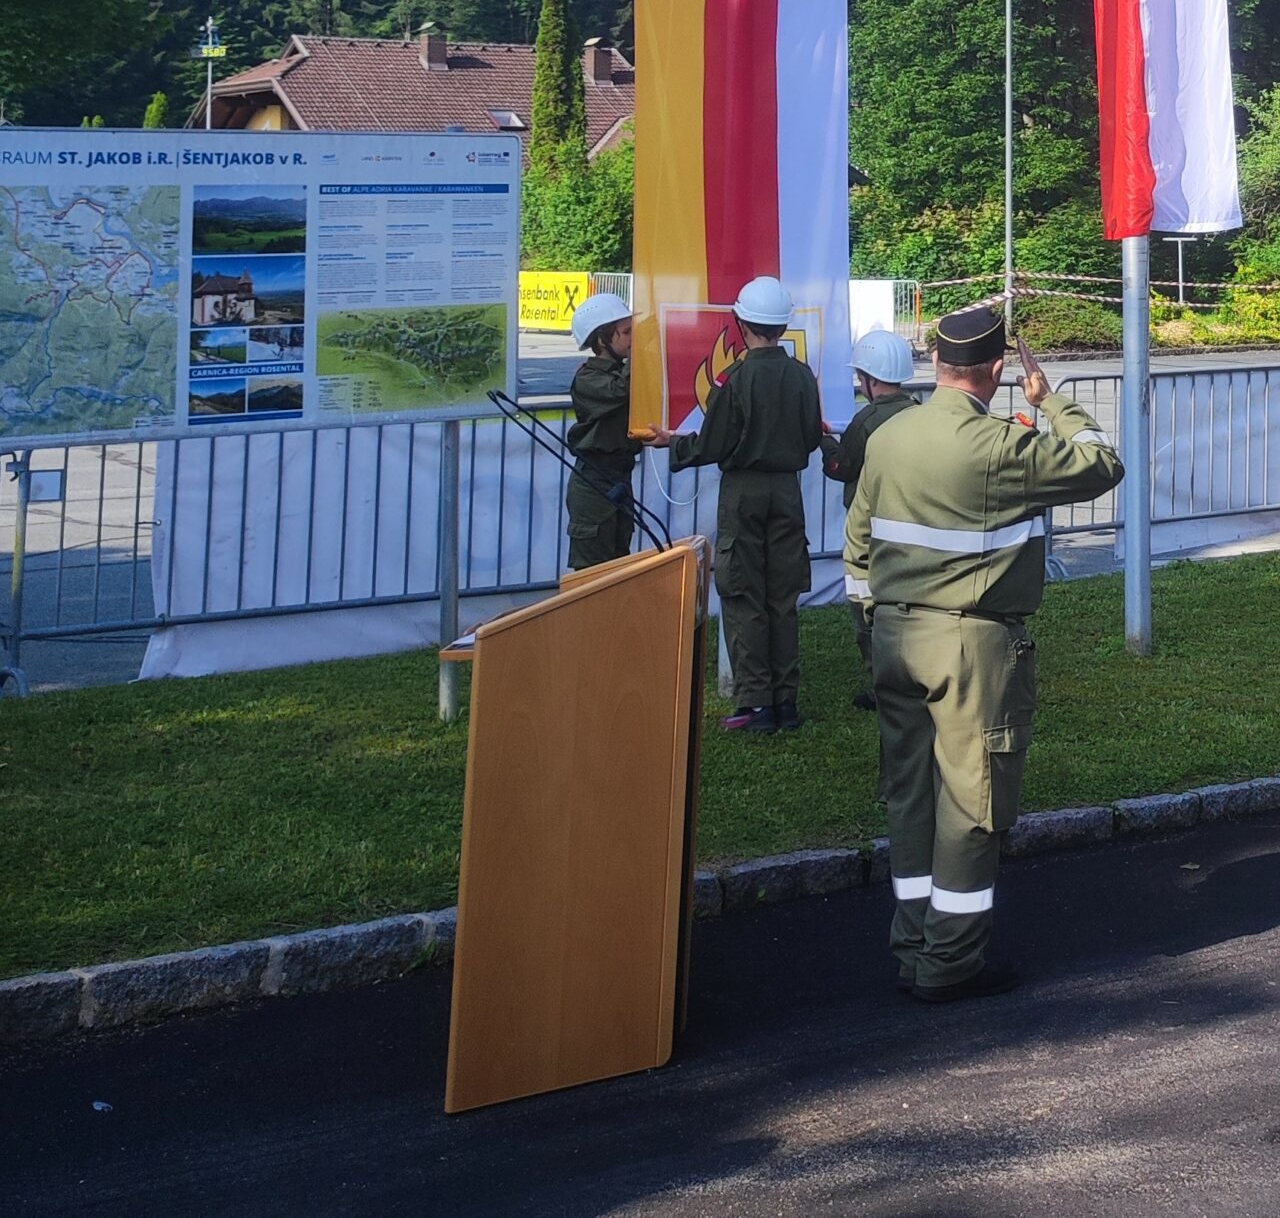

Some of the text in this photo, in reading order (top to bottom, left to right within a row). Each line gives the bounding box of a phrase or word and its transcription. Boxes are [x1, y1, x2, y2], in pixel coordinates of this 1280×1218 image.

[0, 151, 52, 164] RAUM
[57, 151, 82, 165] ST.
[85, 151, 142, 168] JAKOB
[147, 151, 173, 165] i.R.
[182, 149, 275, 168] ŠENTJAKOB
[279, 155, 289, 165] v
[293, 153, 308, 165] R.
[520, 304, 560, 321] Rosental
[191, 364, 301, 377] CARNICA-REGION ROSENTAL
